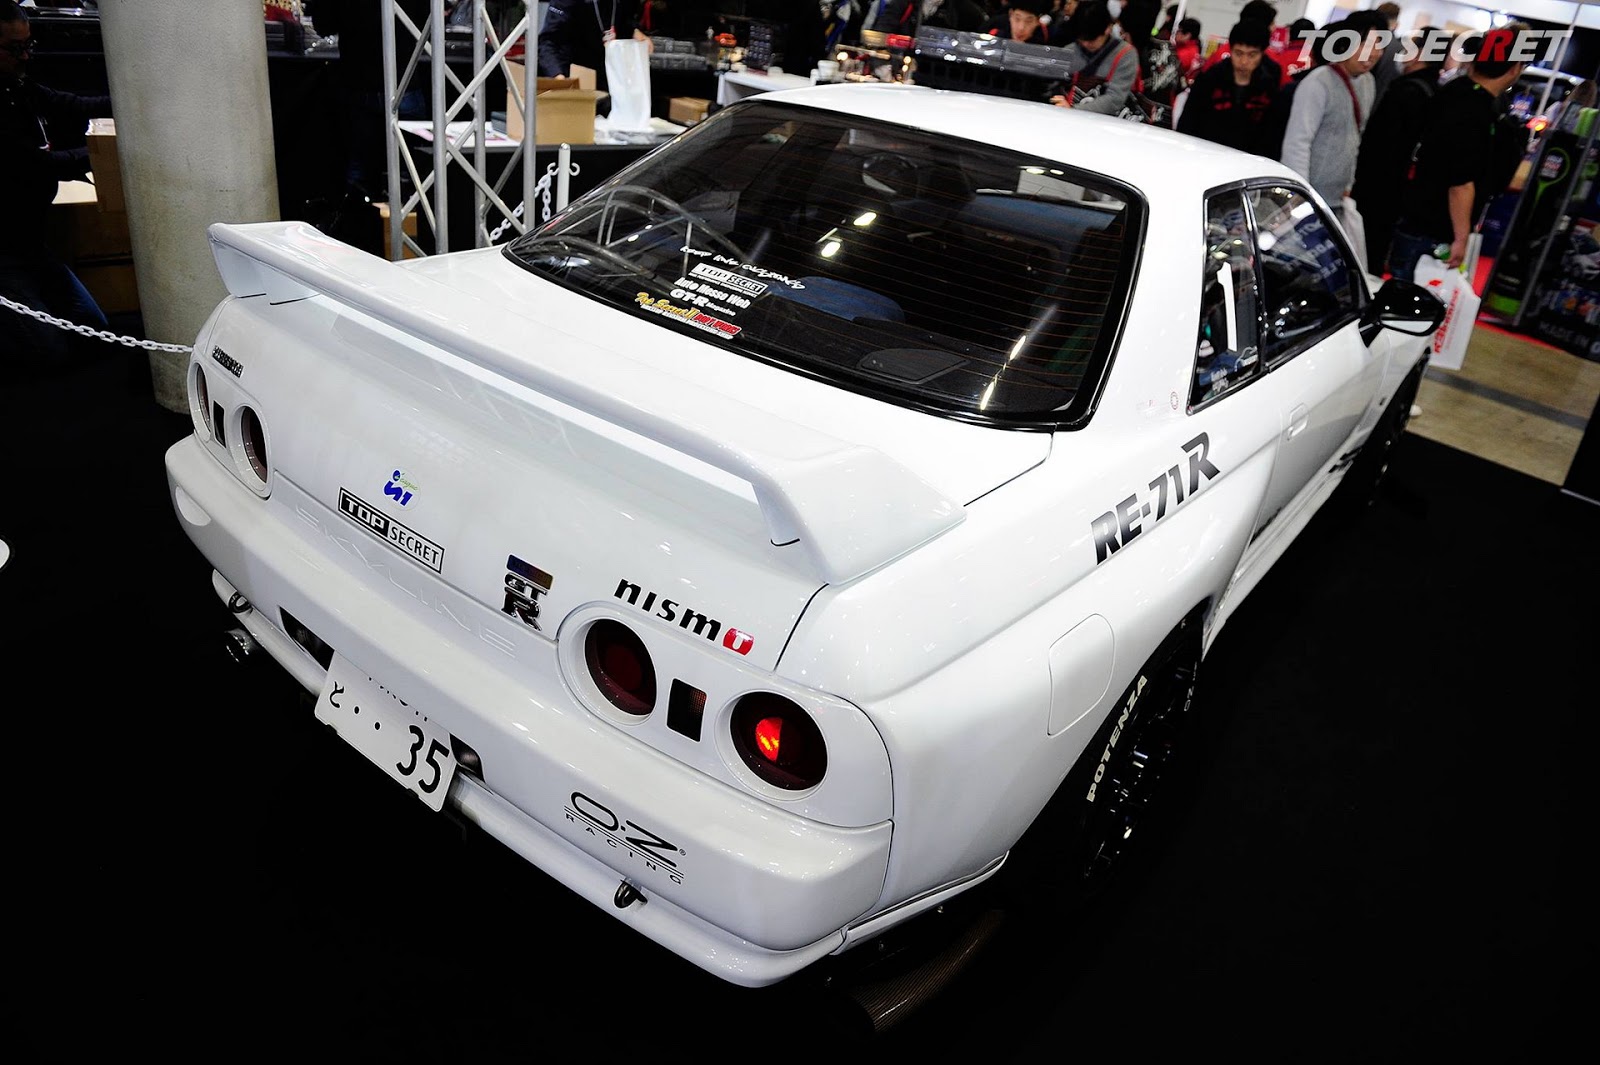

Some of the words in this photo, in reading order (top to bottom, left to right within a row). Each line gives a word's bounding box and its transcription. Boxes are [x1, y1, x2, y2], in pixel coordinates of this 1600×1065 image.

[670, 288, 709, 307] GT-R
[674, 277, 699, 291] Auto
[726, 293, 751, 309] Web
[728, 274, 764, 293] SECRET
[345, 497, 385, 529] TOP
[389, 526, 439, 566] SECRET
[1091, 432, 1220, 565] RE-71R
[1086, 675, 1148, 802] POTENZA
[565, 813, 682, 885] RACING
